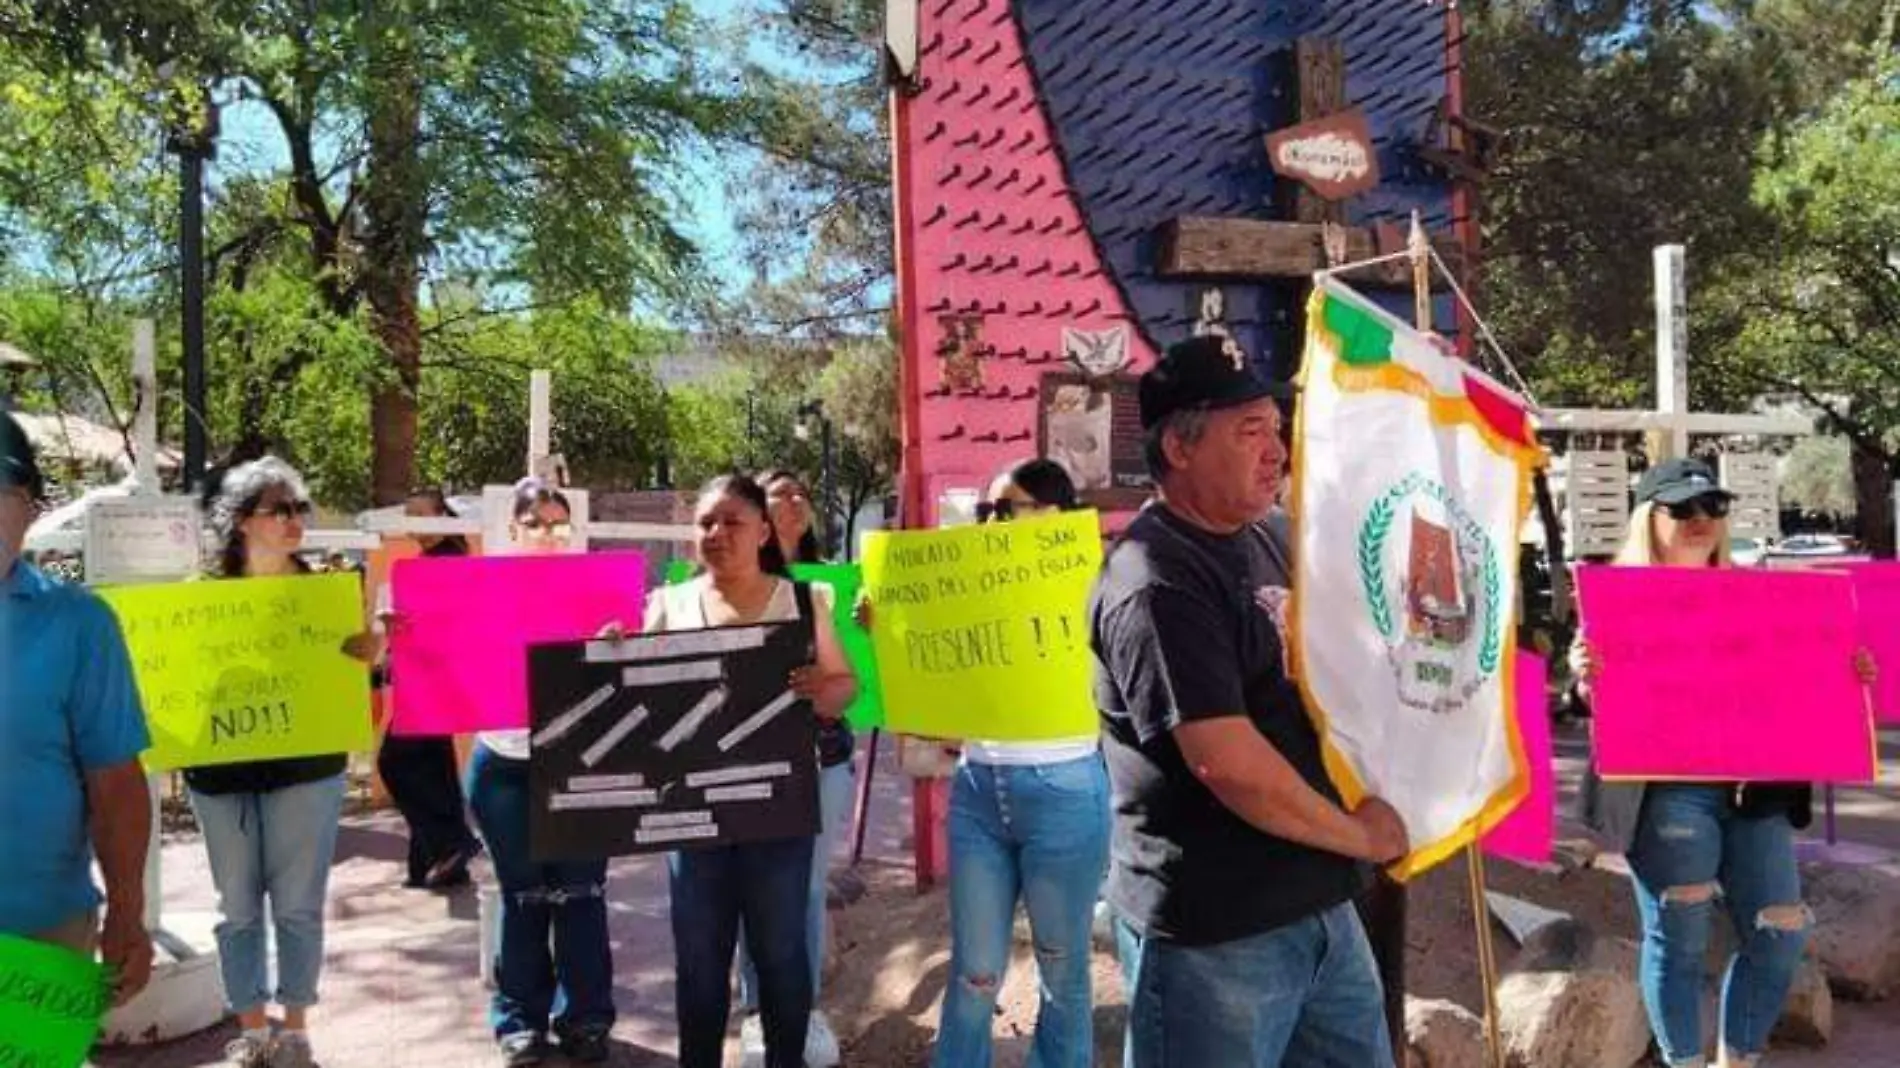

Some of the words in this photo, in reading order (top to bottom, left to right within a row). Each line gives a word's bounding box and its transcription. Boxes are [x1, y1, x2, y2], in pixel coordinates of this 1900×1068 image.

[1034, 528, 1078, 551] SAN
[979, 565, 1031, 592] ORO
[905, 618, 1014, 675] PRESENTE
